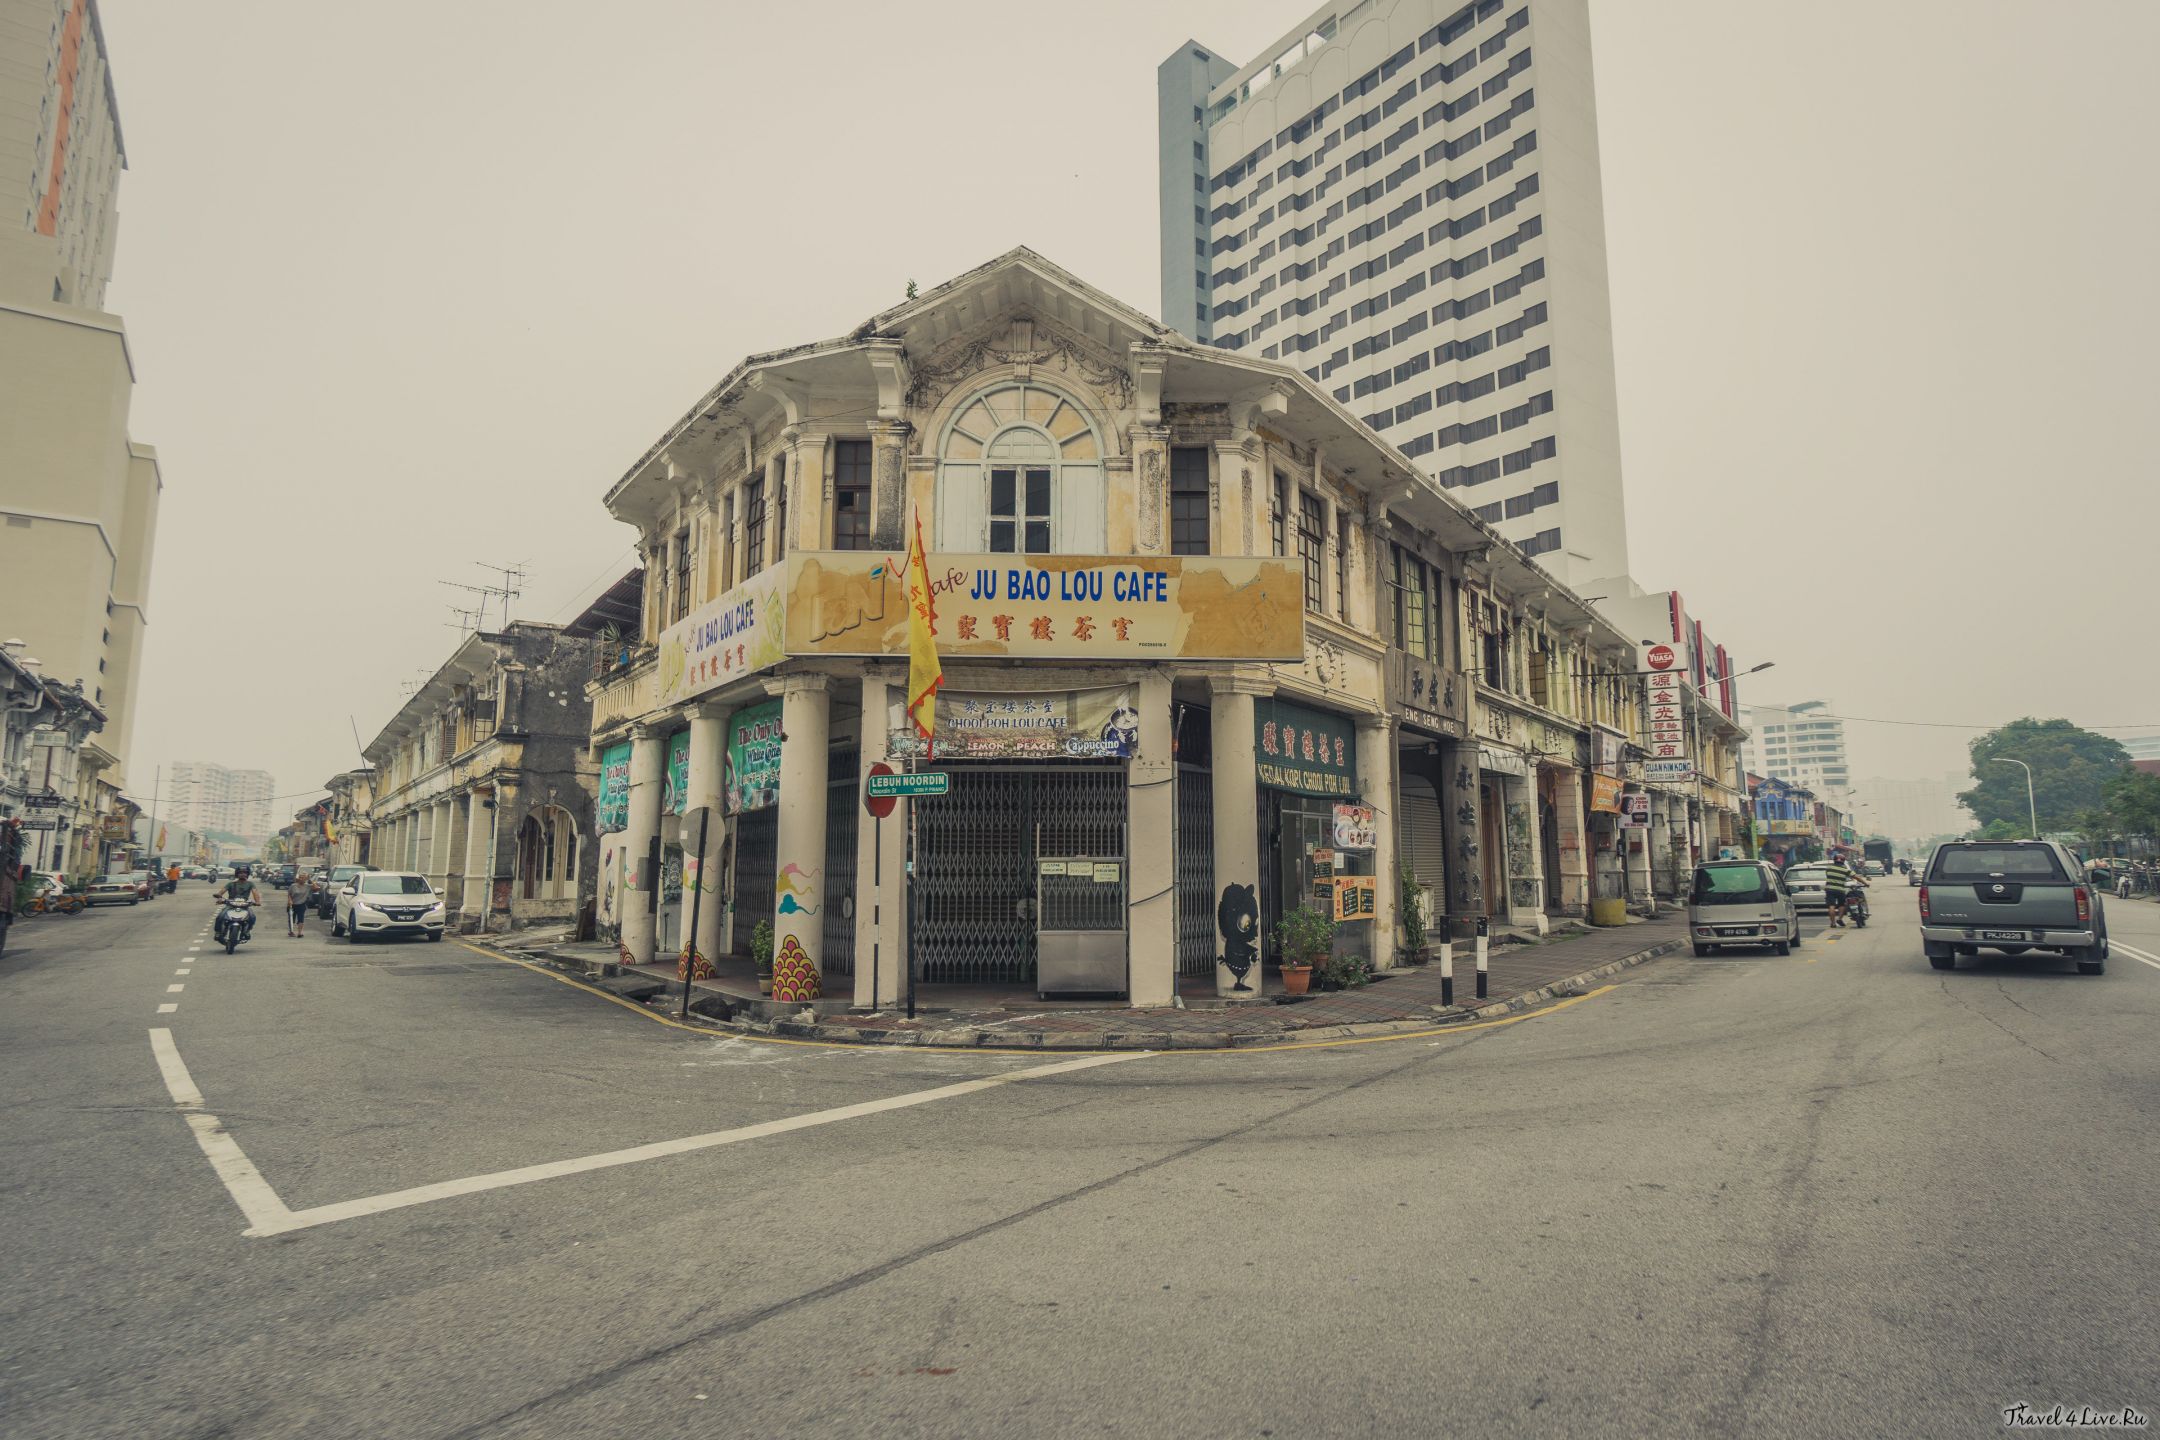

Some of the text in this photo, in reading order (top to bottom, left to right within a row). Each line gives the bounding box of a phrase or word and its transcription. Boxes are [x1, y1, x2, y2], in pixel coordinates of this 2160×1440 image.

[931, 567, 969, 596] afe
[970, 569, 1168, 602] JU BAO LOU CAFE
[696, 627, 704, 652] JU
[705, 618, 718, 648] BAO
[720, 609, 734, 640] LOU
[736, 599, 754, 633] CAFE
[1649, 653, 1674, 662] YUASA
[948, 717, 1067, 729] CHOOI POH LOU CAFE
[1405, 707, 1454, 734] ENG SENG HOE
[754, 720, 771, 743] Only
[968, 742, 1005, 750] LEMON
[1016, 742, 1056, 750] PEACH
[1066, 737, 1120, 754] Cappuccino
[1657, 743, 1677, 757] 商
[872, 775, 945, 787] LEBUH NOORDIN
[1258, 763, 1285, 786] KEDAI
[1285, 768, 1304, 789] KOPI
[1325, 774, 1338, 793] POH
[1338, 776, 1351, 794] LOU
